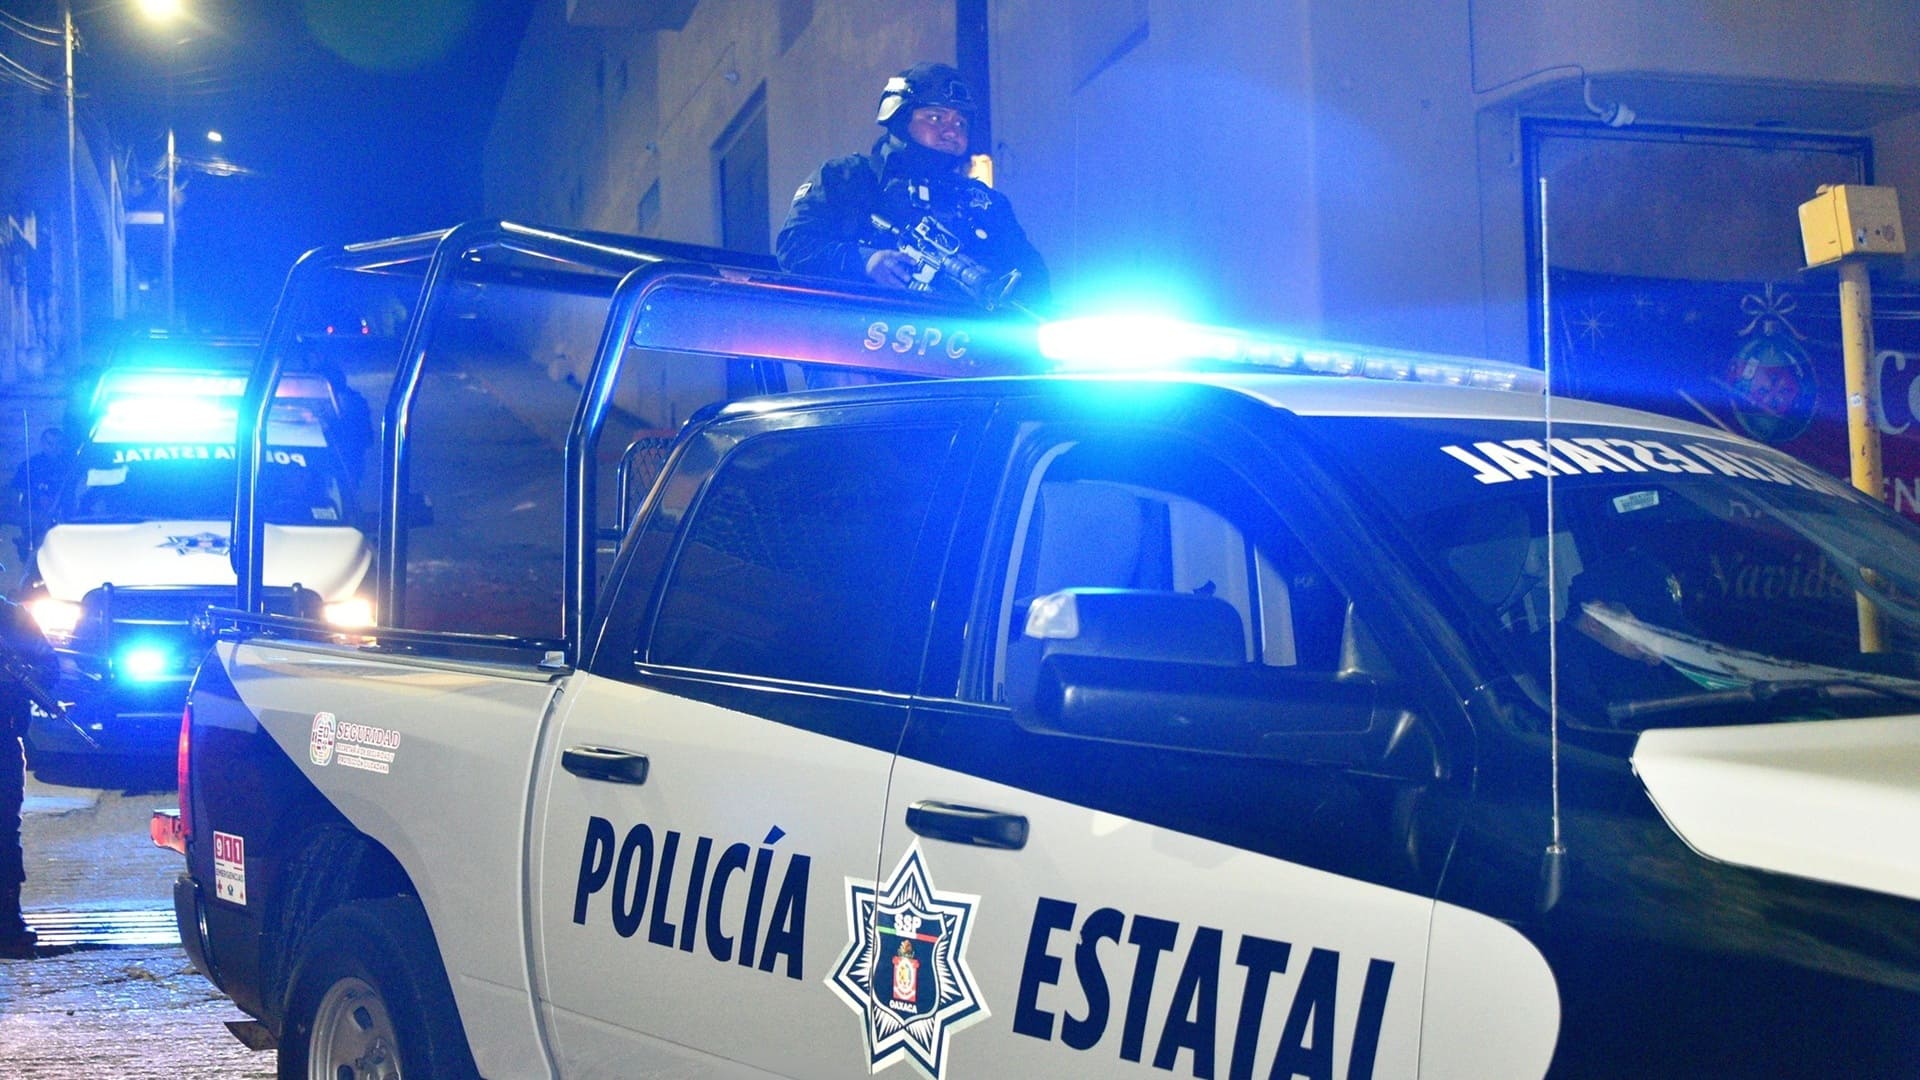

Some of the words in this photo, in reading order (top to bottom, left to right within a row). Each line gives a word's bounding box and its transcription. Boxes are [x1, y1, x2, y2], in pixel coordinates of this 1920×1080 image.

[864, 321, 970, 359] SSPC
[337, 722, 399, 748] SEGURIDAD
[216, 838, 240, 861] 911
[573, 816, 811, 980] POLICÍA
[894, 913, 922, 933] SSP
[889, 1000, 918, 1014] OAXACA
